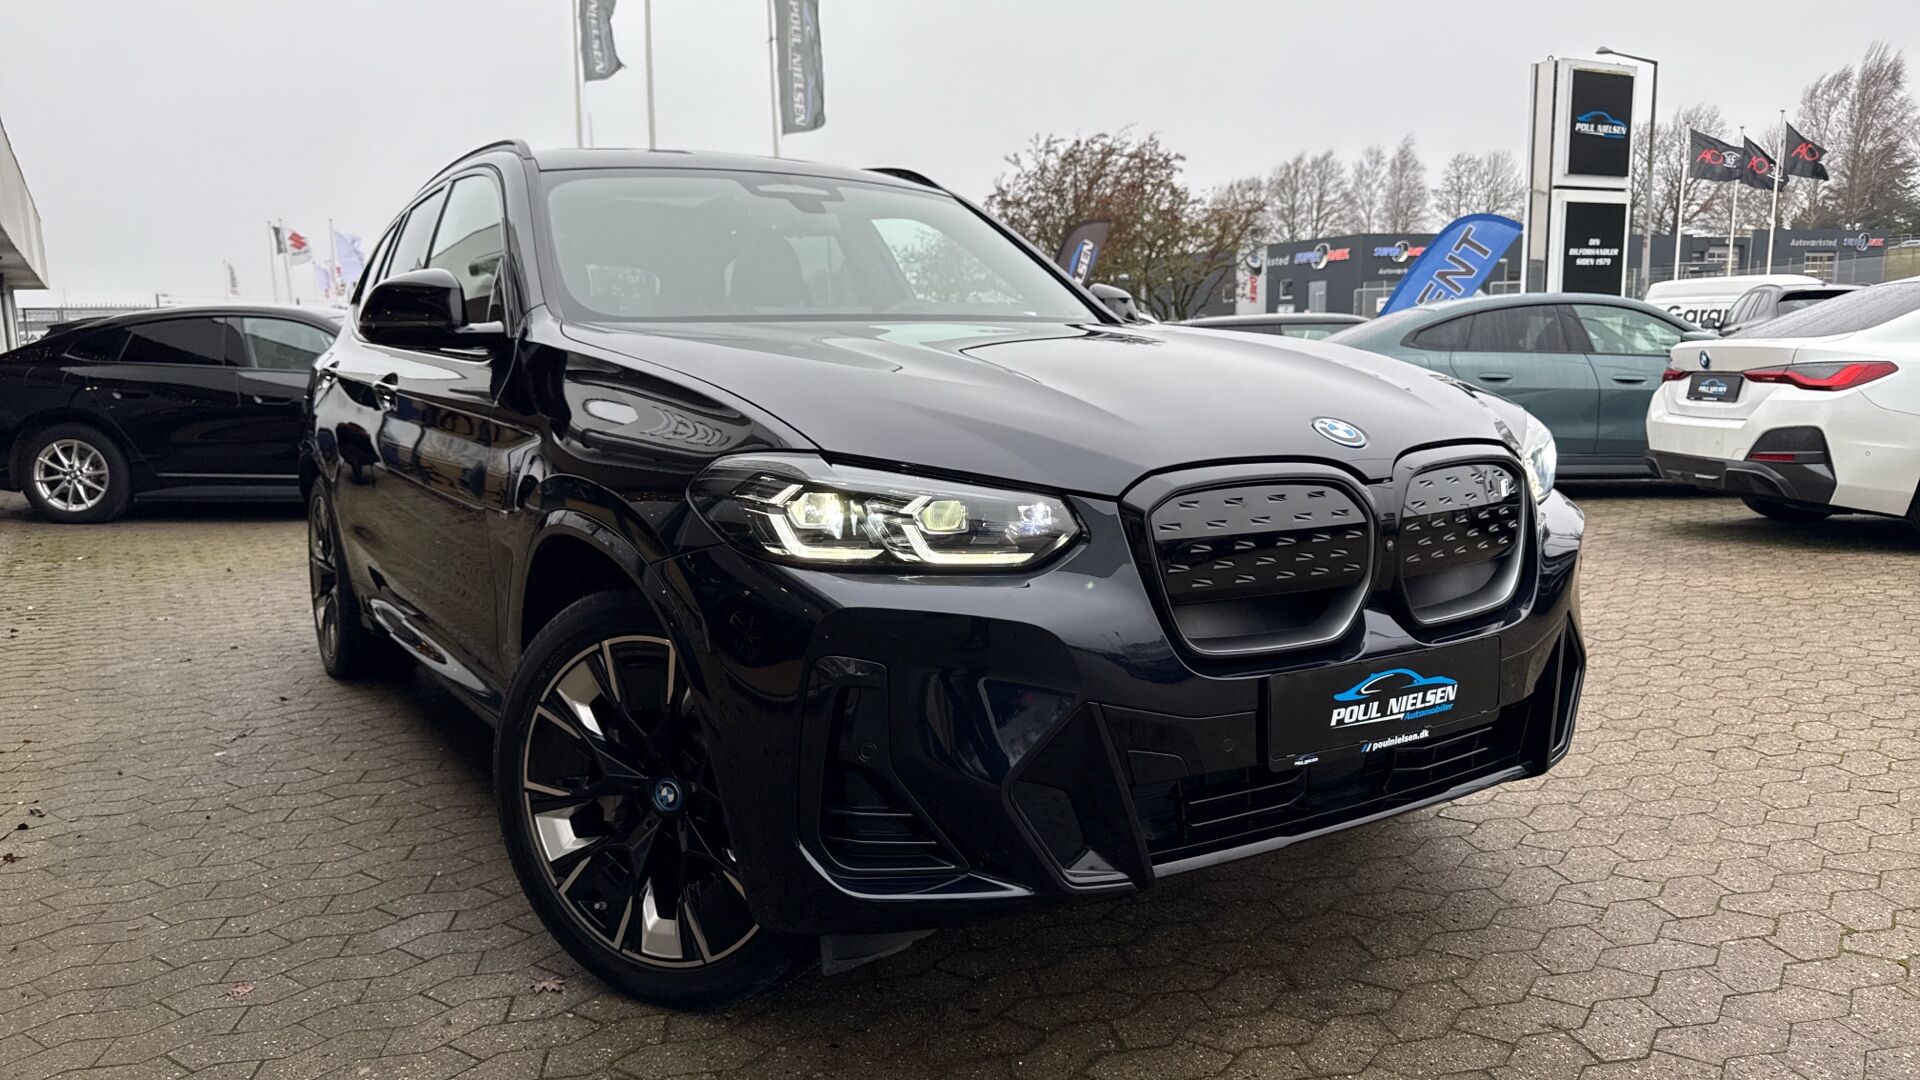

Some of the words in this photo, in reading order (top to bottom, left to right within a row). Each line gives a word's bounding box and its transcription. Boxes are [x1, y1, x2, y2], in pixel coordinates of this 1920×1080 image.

[788, 0, 802, 46] POUL
[791, 52, 806, 126] NIELSEN
[1575, 122, 1595, 132] POUL
[1596, 124, 1627, 135] NIELSEN
[1588, 238, 1601, 246] DIN
[1790, 238, 1838, 248] Autoværksted
[1568, 247, 1619, 256] BILFORHANDLER
[1575, 257, 1595, 266] SIDEN
[1595, 257, 1612, 266] 1979
[1330, 701, 1381, 726] POUL
[1387, 684, 1458, 715] NIELSEN
[1404, 702, 1455, 720] Automobiler
